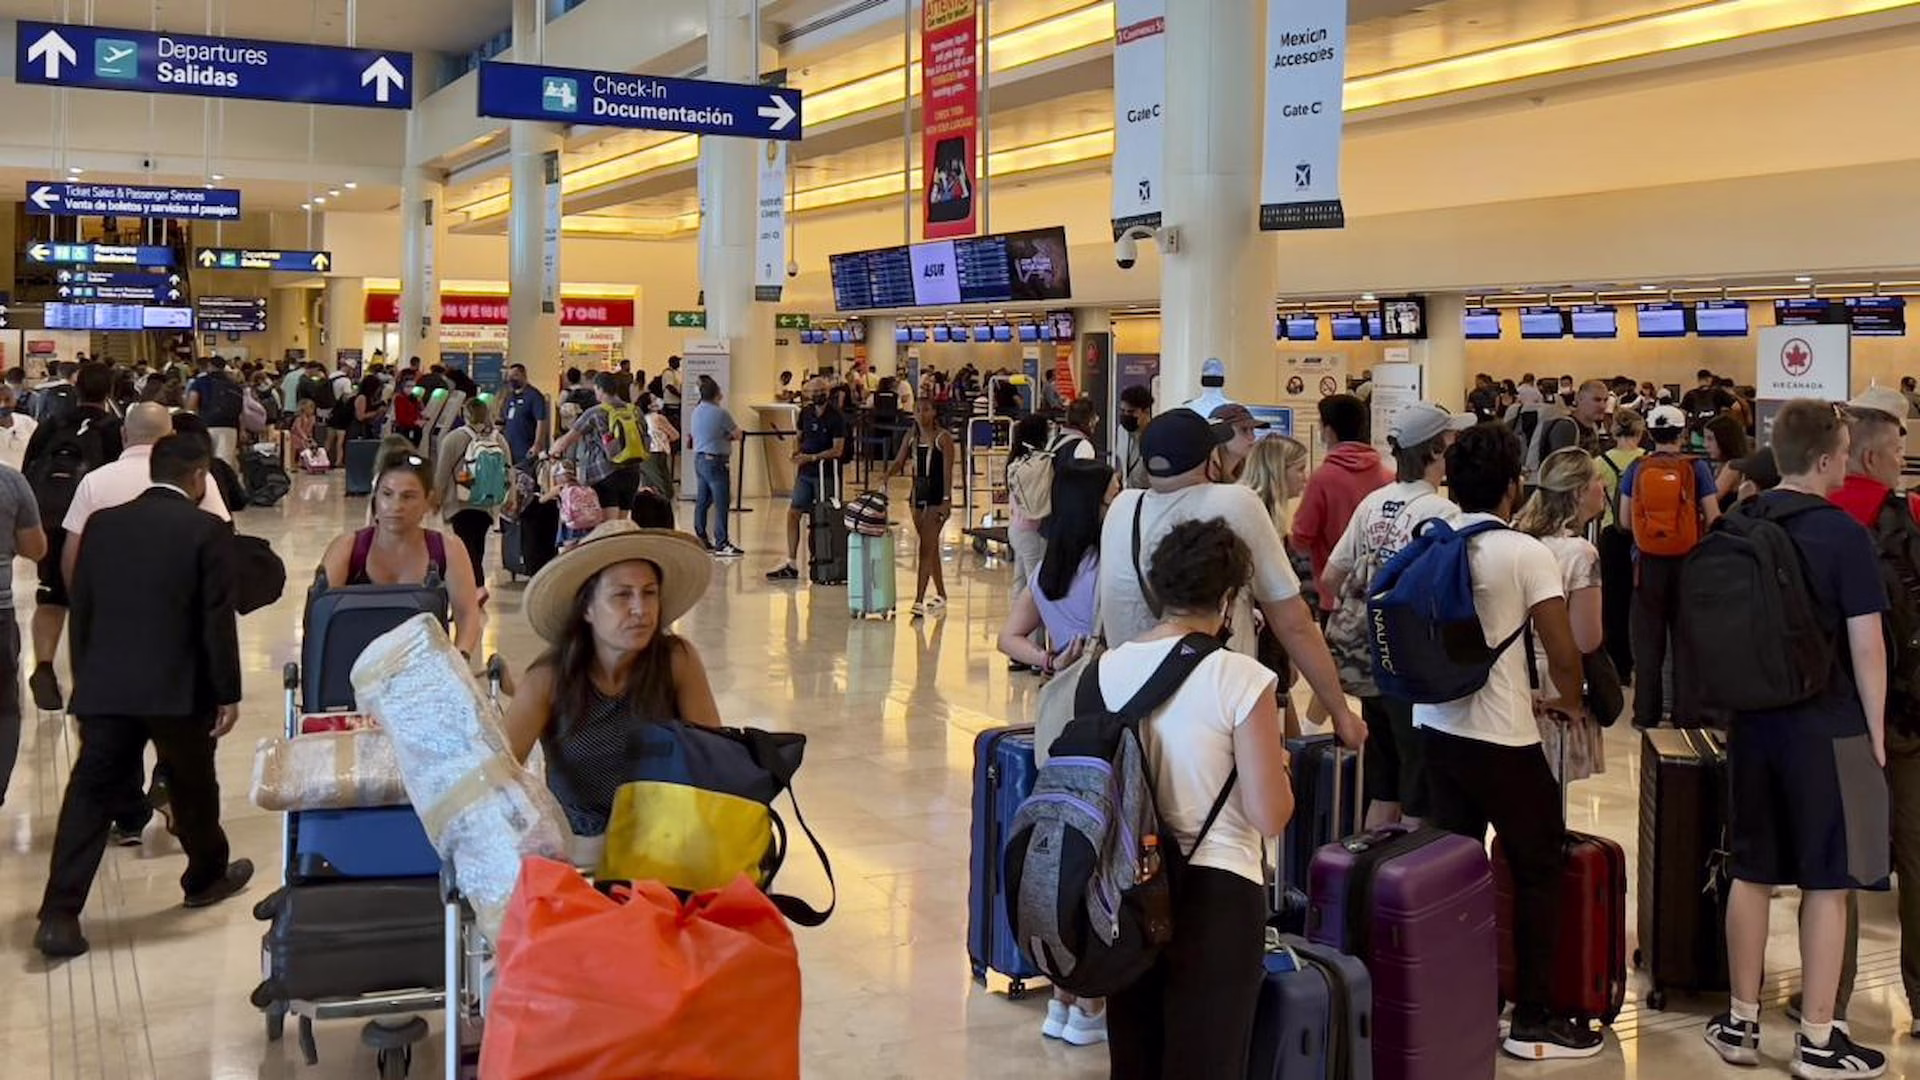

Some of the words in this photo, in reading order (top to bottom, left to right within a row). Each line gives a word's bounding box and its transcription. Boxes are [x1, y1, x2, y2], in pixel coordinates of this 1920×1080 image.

[1280, 27, 1327, 47] Mexican
[157, 37, 268, 65] Departures
[157, 63, 239, 88] Salidas
[593, 75, 667, 99] Check-In
[592, 97, 734, 126] Documentación
[1127, 108, 1151, 123] Gate
[1282, 104, 1309, 118] Gate
[65, 185, 91, 197] Ticket
[92, 186, 115, 198] Sales
[116, 187, 125, 198] &
[126, 188, 169, 202] Passenger
[170, 189, 205, 202] Services
[64, 197, 93, 210] Venta
[94, 199, 107, 211] de
[107, 200, 143, 213] boletos
[143, 203, 151, 214] y
[151, 202, 190, 214] servicios
[191, 202, 200, 214] al
[200, 204, 238, 217] pasajero
